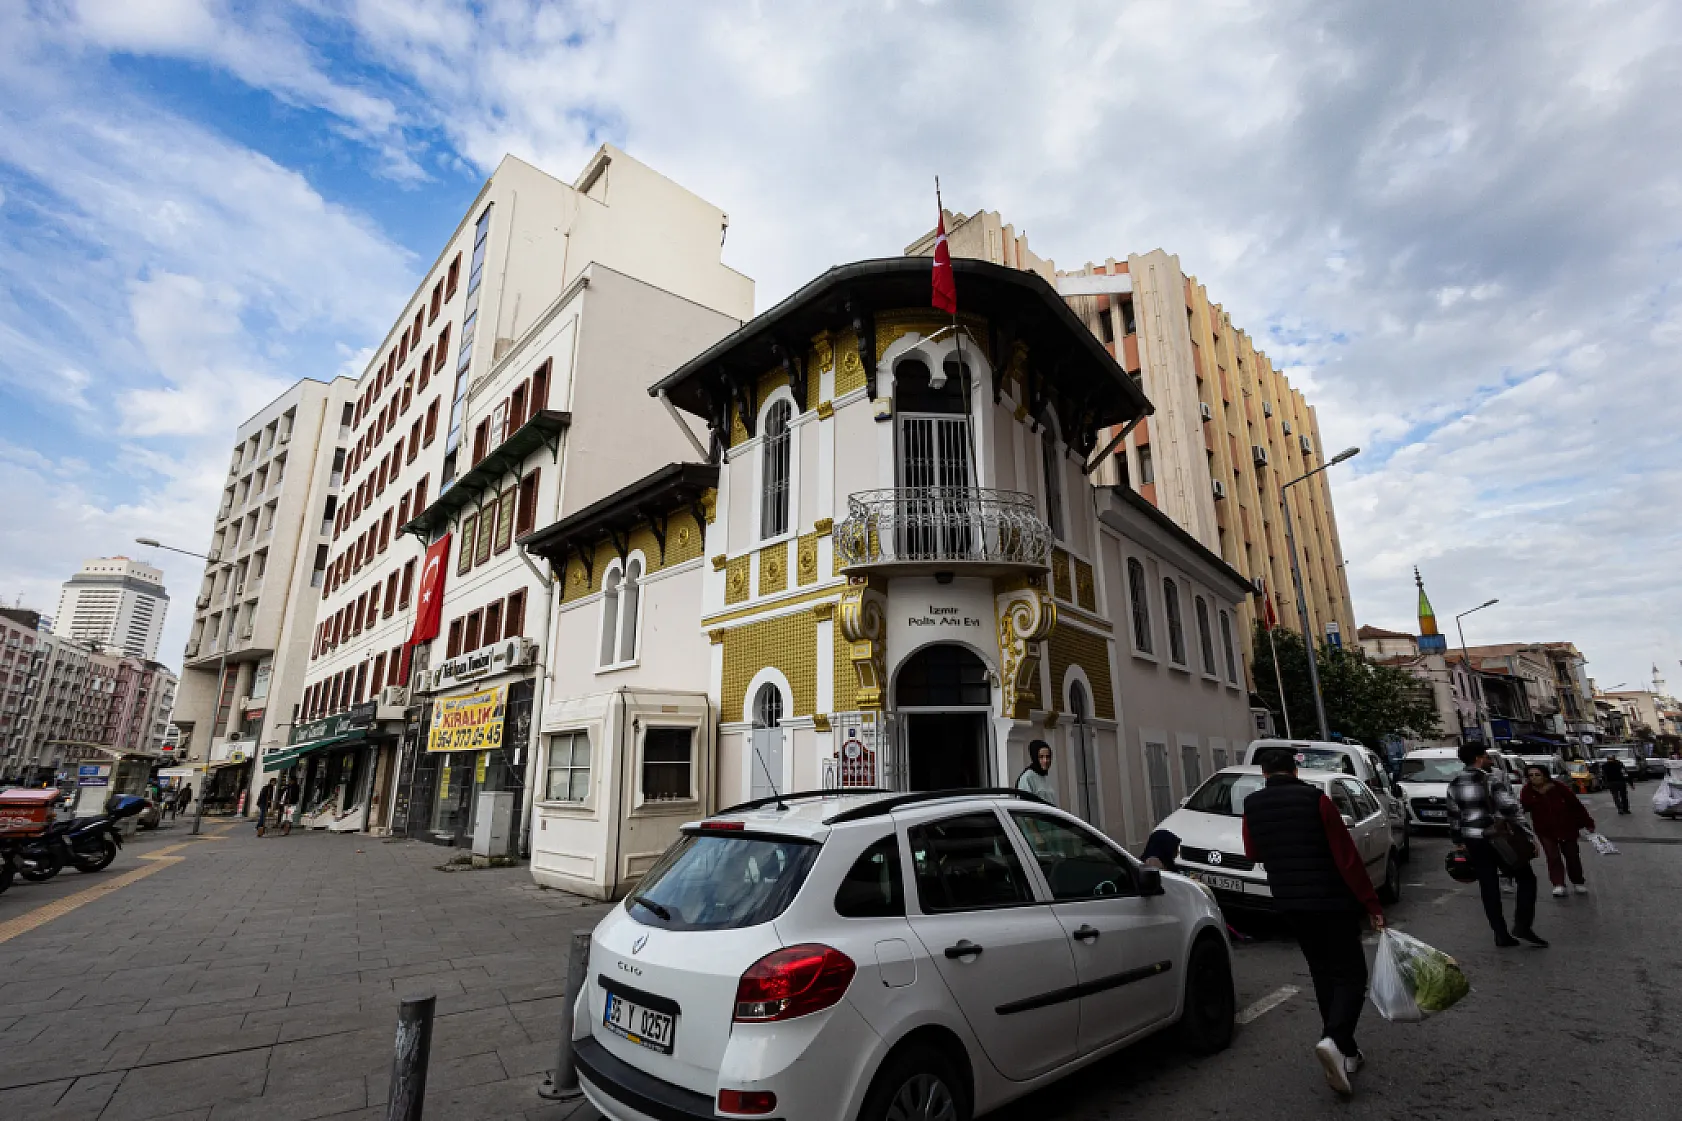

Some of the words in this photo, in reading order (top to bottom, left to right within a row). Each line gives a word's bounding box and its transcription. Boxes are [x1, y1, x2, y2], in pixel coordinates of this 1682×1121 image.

[908, 615, 936, 626] Polis
[963, 617, 980, 627] Evi
[617, 960, 643, 976] CLIO
[640, 1010, 671, 1042] 0257
